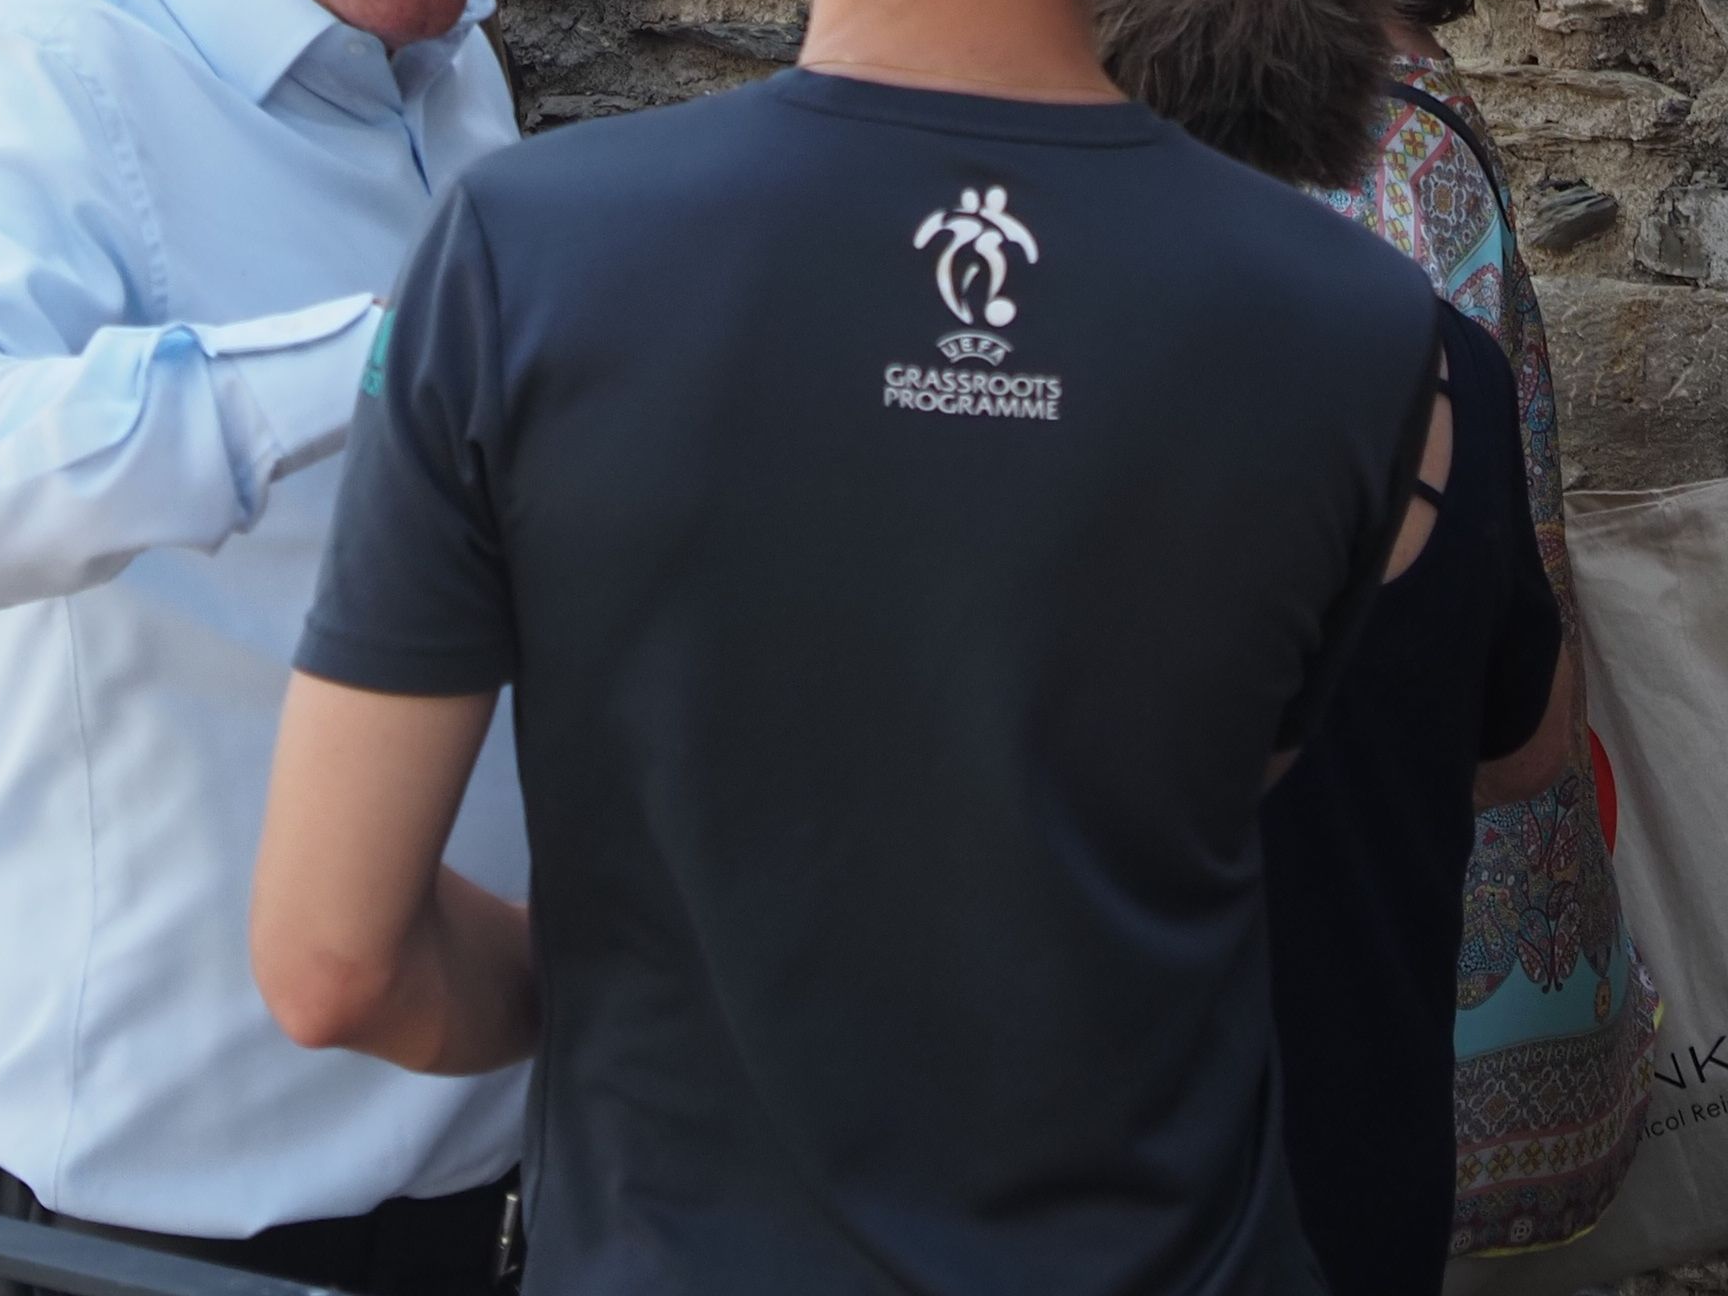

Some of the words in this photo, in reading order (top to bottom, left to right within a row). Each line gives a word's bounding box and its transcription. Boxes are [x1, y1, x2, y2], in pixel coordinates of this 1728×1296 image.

[940, 336, 1004, 360] UEFA
[884, 365, 1061, 398] GRASSROOTS
[884, 386, 1060, 420] PROGRAMME
[1636, 1108, 1686, 1142] icol
